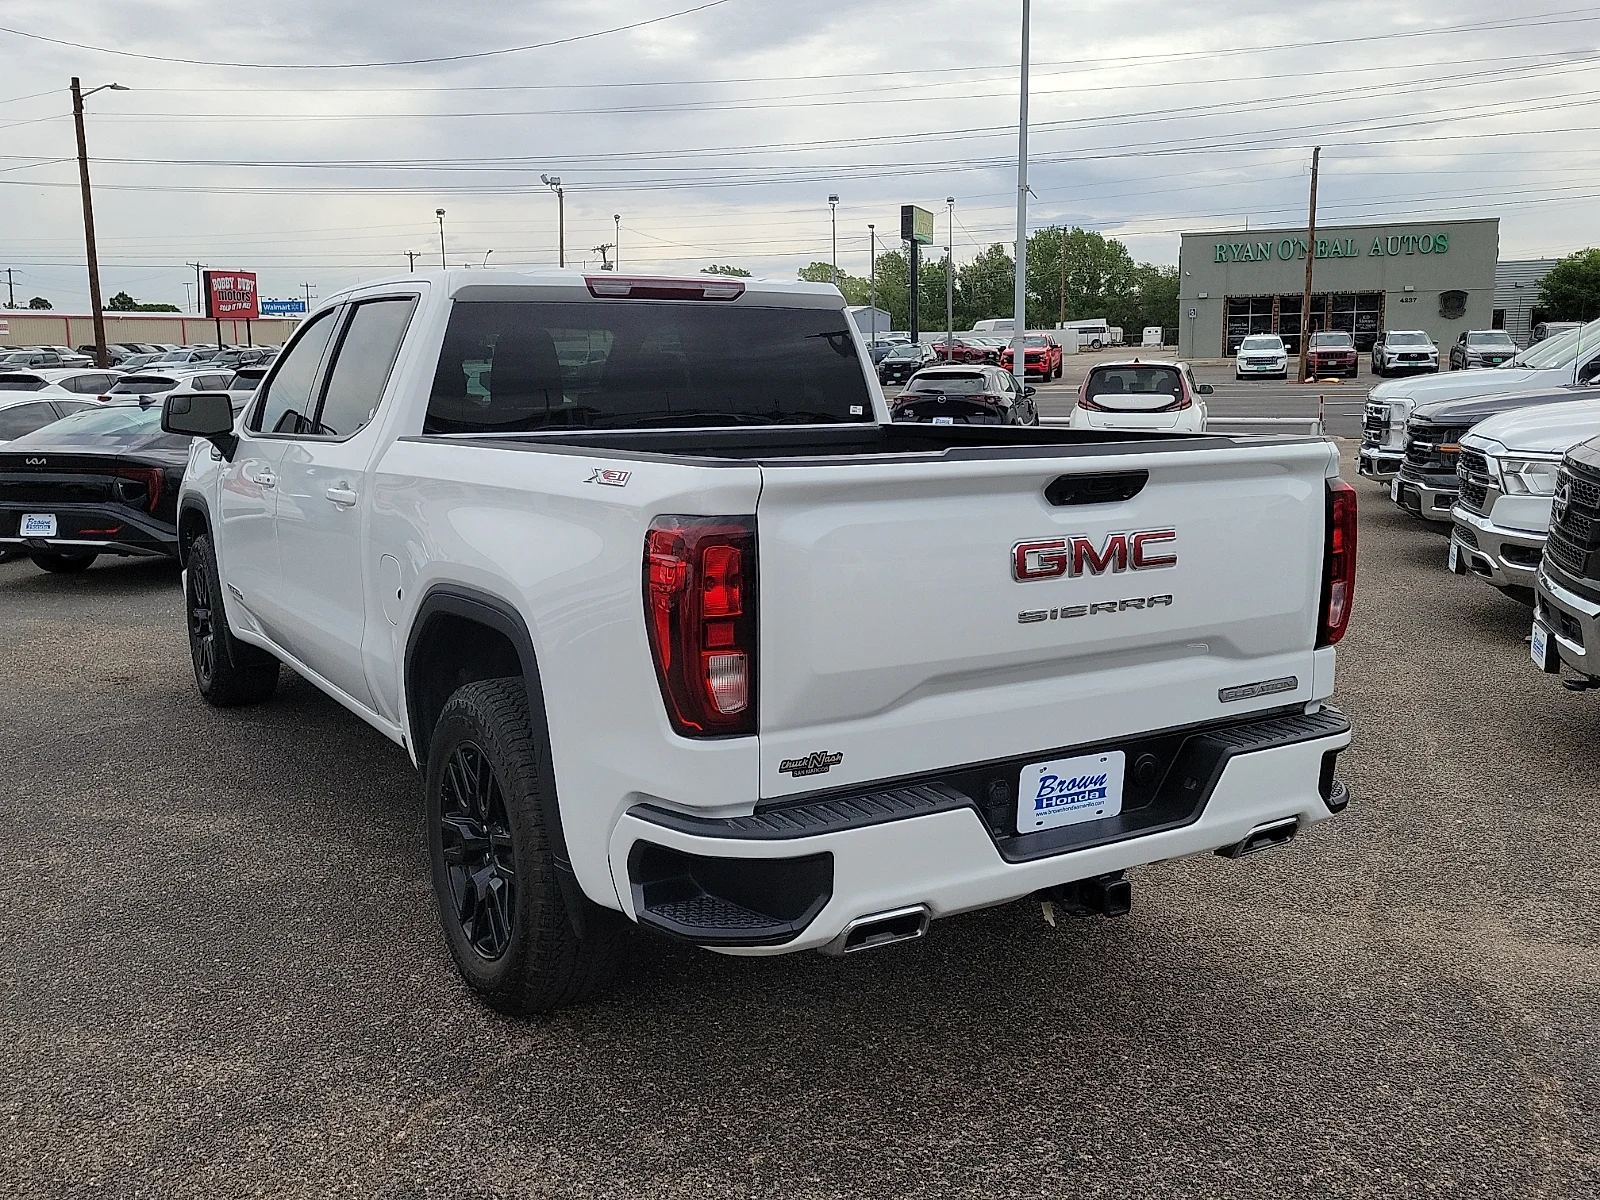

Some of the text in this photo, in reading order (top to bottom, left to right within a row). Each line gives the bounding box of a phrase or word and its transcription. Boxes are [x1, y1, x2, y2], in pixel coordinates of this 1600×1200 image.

[1214, 241, 1272, 263] RYAN
[1369, 232, 1449, 257] AUTOS
[212, 277, 234, 291] BOBBY
[218, 290, 251, 302] motors
[263, 303, 291, 311] Walmart
[25, 457, 47, 465] KIA
[1011, 527, 1178, 583] GMC
[1017, 594, 1174, 624] SIERRA
[780, 759, 808, 769] Chuck
[1036, 773, 1108, 798] Brown
[1042, 790, 1100, 808] Honda
